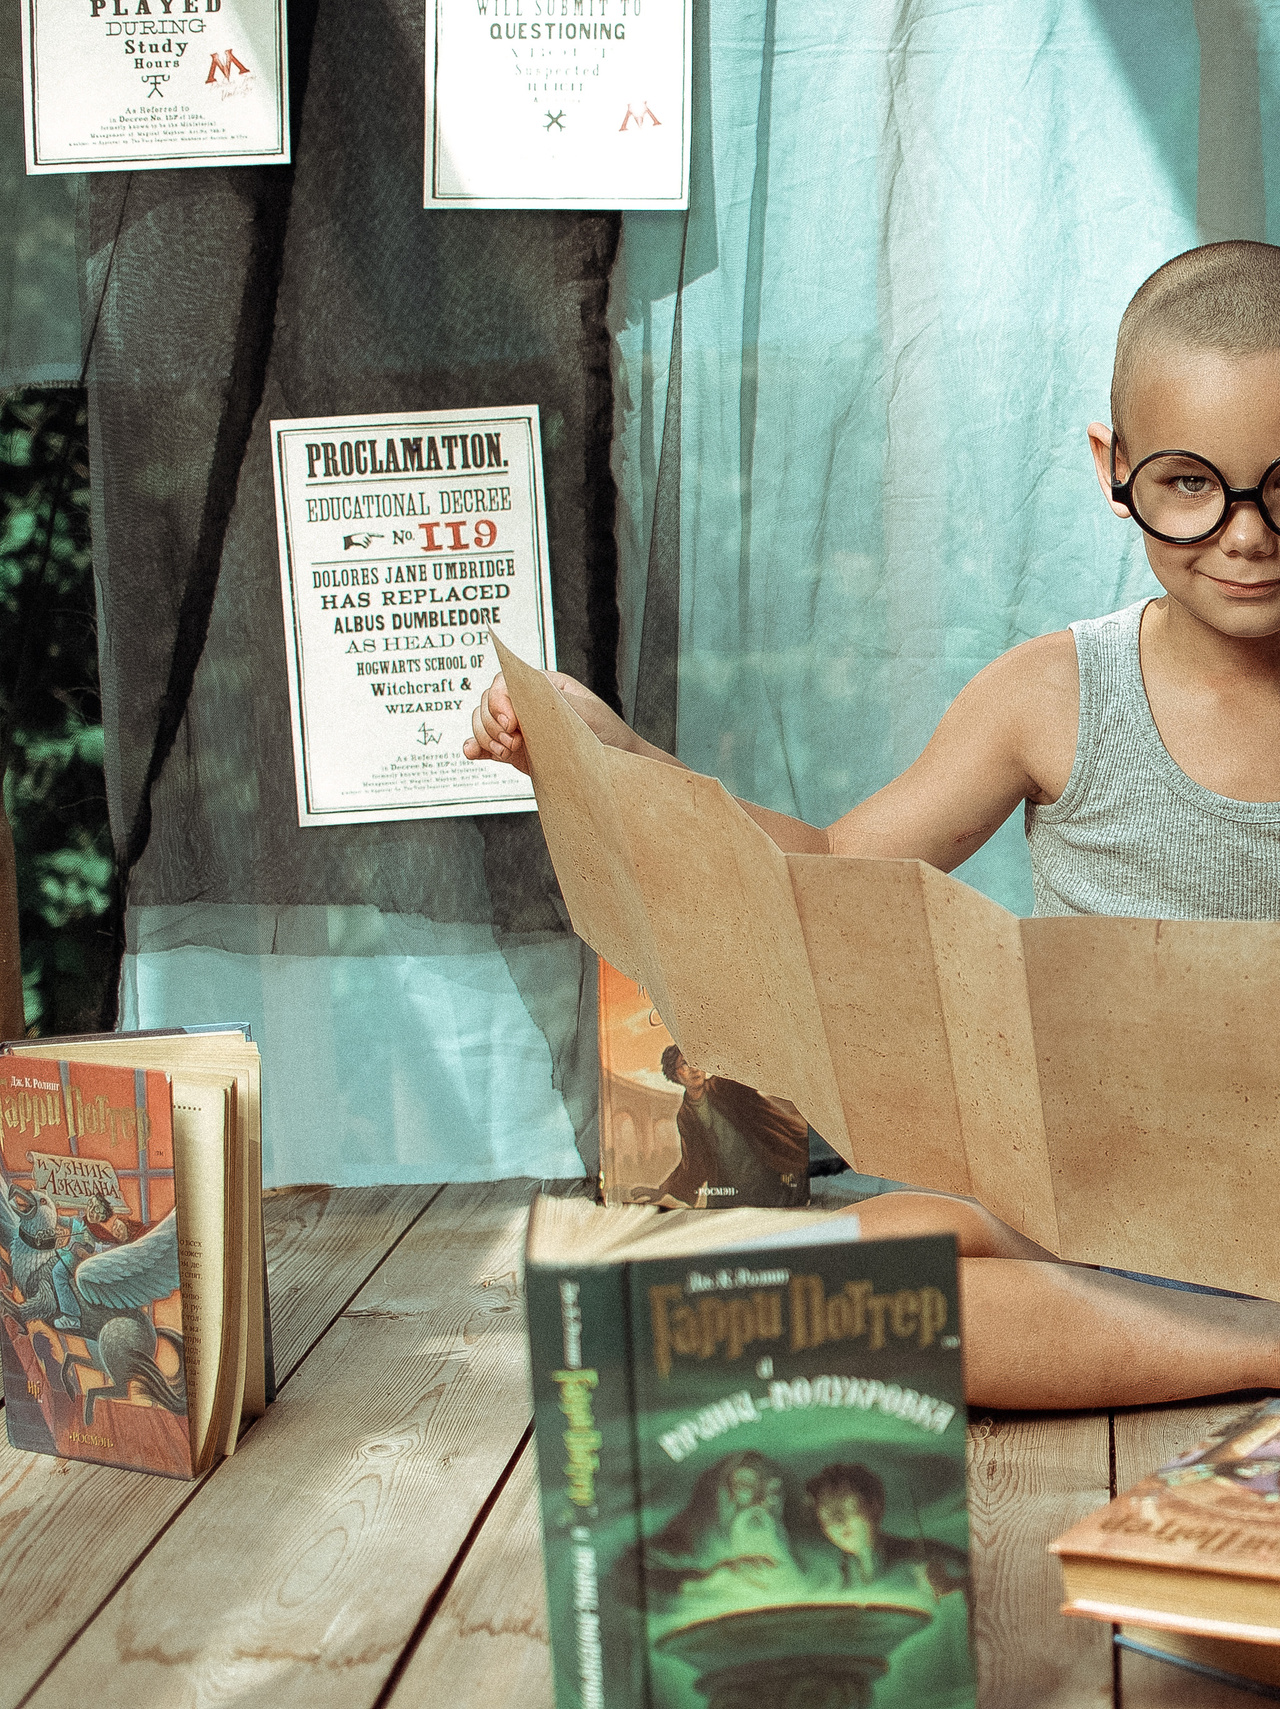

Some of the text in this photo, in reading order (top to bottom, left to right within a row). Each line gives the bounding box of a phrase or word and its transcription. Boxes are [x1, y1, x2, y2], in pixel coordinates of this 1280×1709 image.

[90, 0, 222, 17] PLAYED
[477, 0, 641, 16] WILL SUBMIT TO
[106, 19, 207, 36] DURING
[490, 22, 626, 40] QUESTIONING
[125, 39, 189, 57] Study
[134, 58, 180, 69] Hours
[140, 106, 177, 114] Referred
[305, 432, 509, 478] PROCLAMATION.
[305, 486, 512, 523] EDUCATIONAL DECREE
[418, 519, 498, 552] 119
[312, 558, 516, 589] DOLORES JANE UMBRIDGE
[320, 583, 511, 610] HAS REPLACED
[333, 606, 501, 634] ALBUS DUMBLEDORE
[345, 631, 491, 654] AS HEAD OF
[356, 654, 485, 676] HOGWARTS SCHOOL OF
[370, 677, 472, 697] Witchcraft &
[385, 700, 463, 715] WIZARDRY
[11, 1076, 24, 1088] Дж.
[33, 1079, 60, 1091] Ролинг
[0, 1082, 151, 1151] арри Поттер
[648, 1283, 782, 1381] Гарри
[789, 1274, 948, 1351] Поттер
